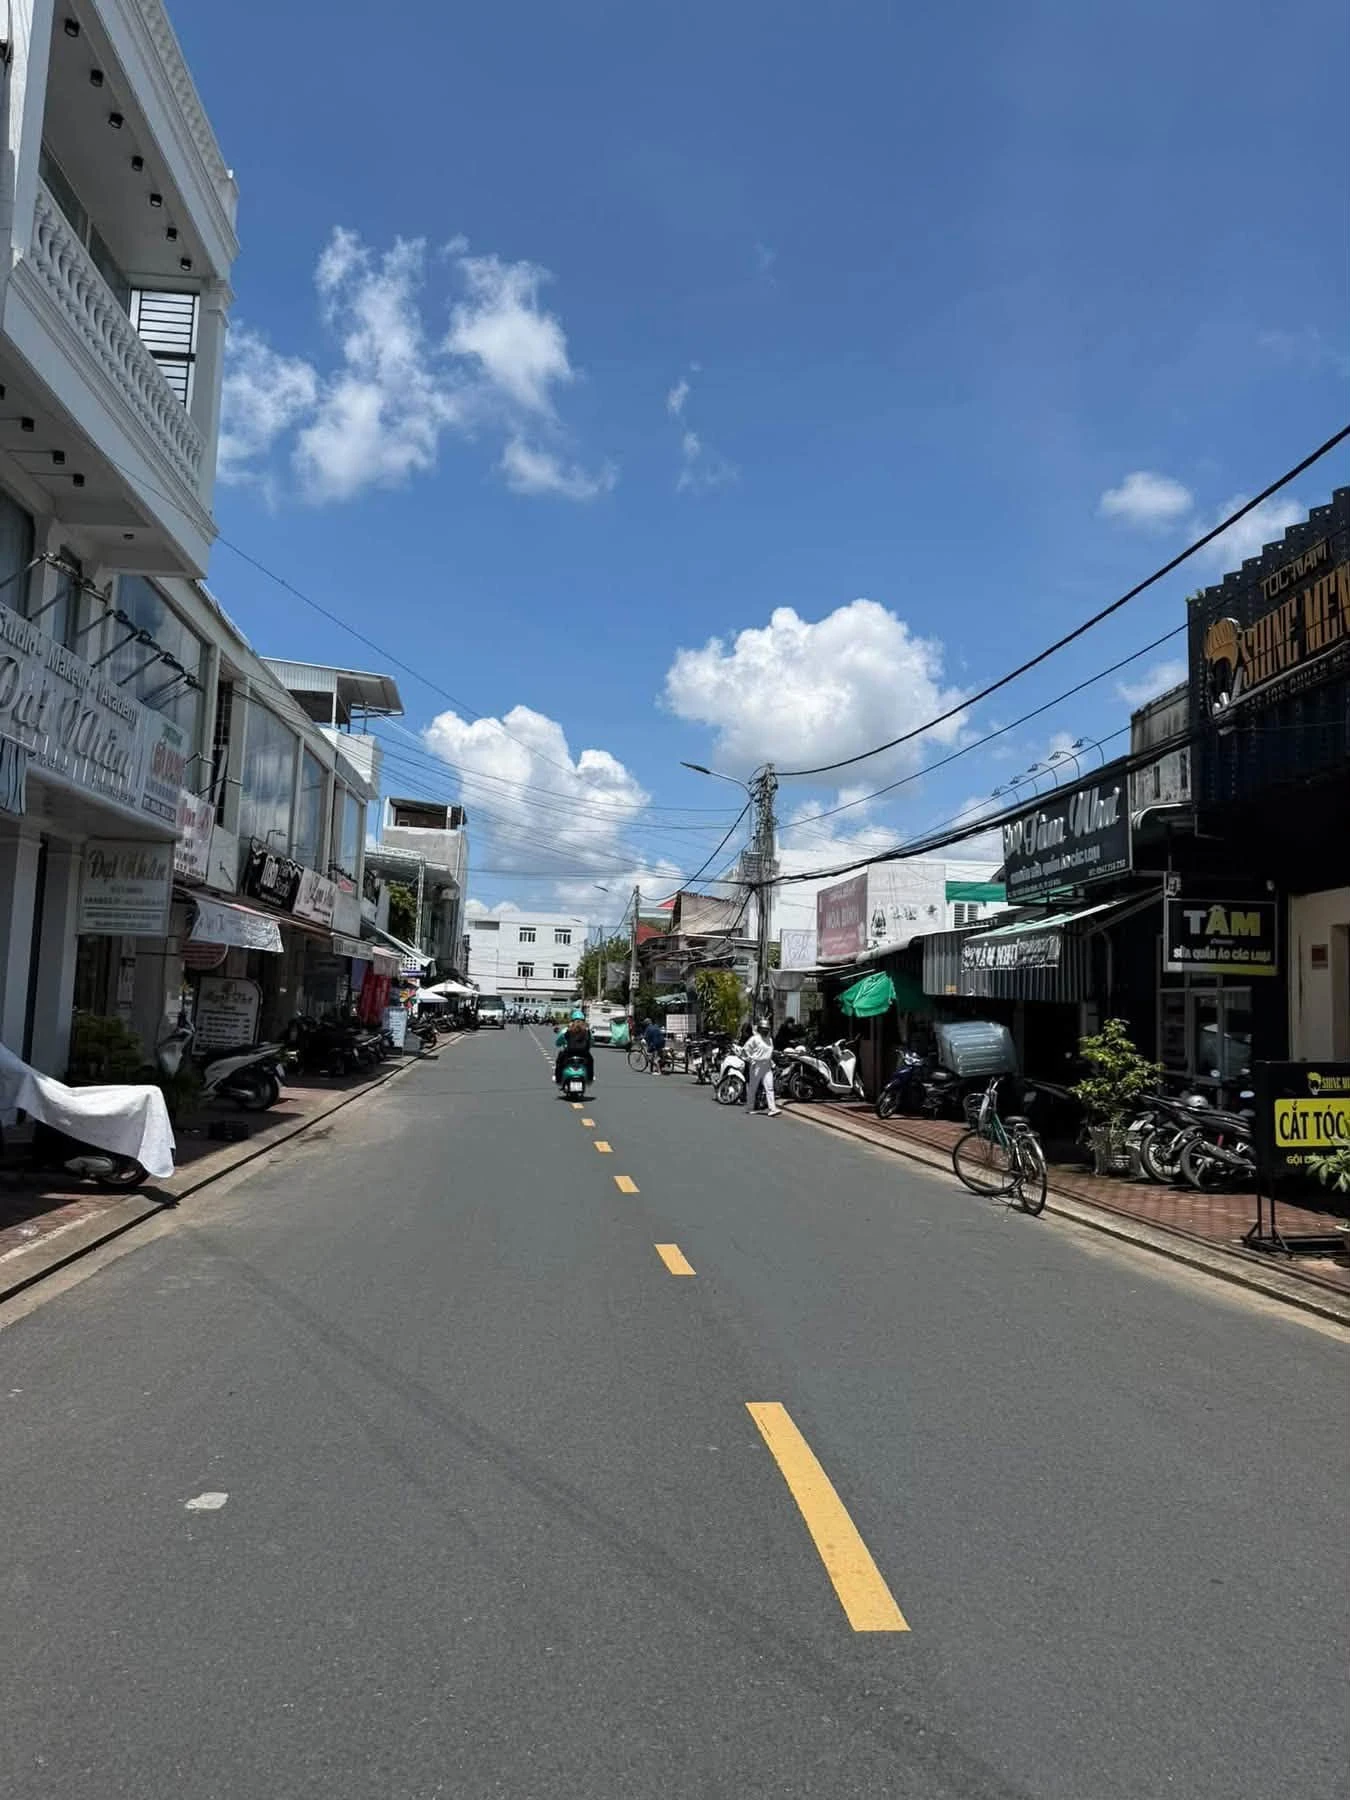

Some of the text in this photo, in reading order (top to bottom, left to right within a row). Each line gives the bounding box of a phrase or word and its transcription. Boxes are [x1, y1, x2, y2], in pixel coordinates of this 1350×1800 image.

[1292, 541, 1327, 582] NAM
[1241, 597, 1299, 689] SHINE
[47, 645, 91, 691] Makeup
[1183, 904, 1261, 936] TÂM
[1218, 946, 1231, 960] ÁO
[1232, 947, 1249, 960] CÁC
[1322, 1076, 1341, 1089] SHINE
[1279, 1100, 1345, 1140] CẮT TÓC
